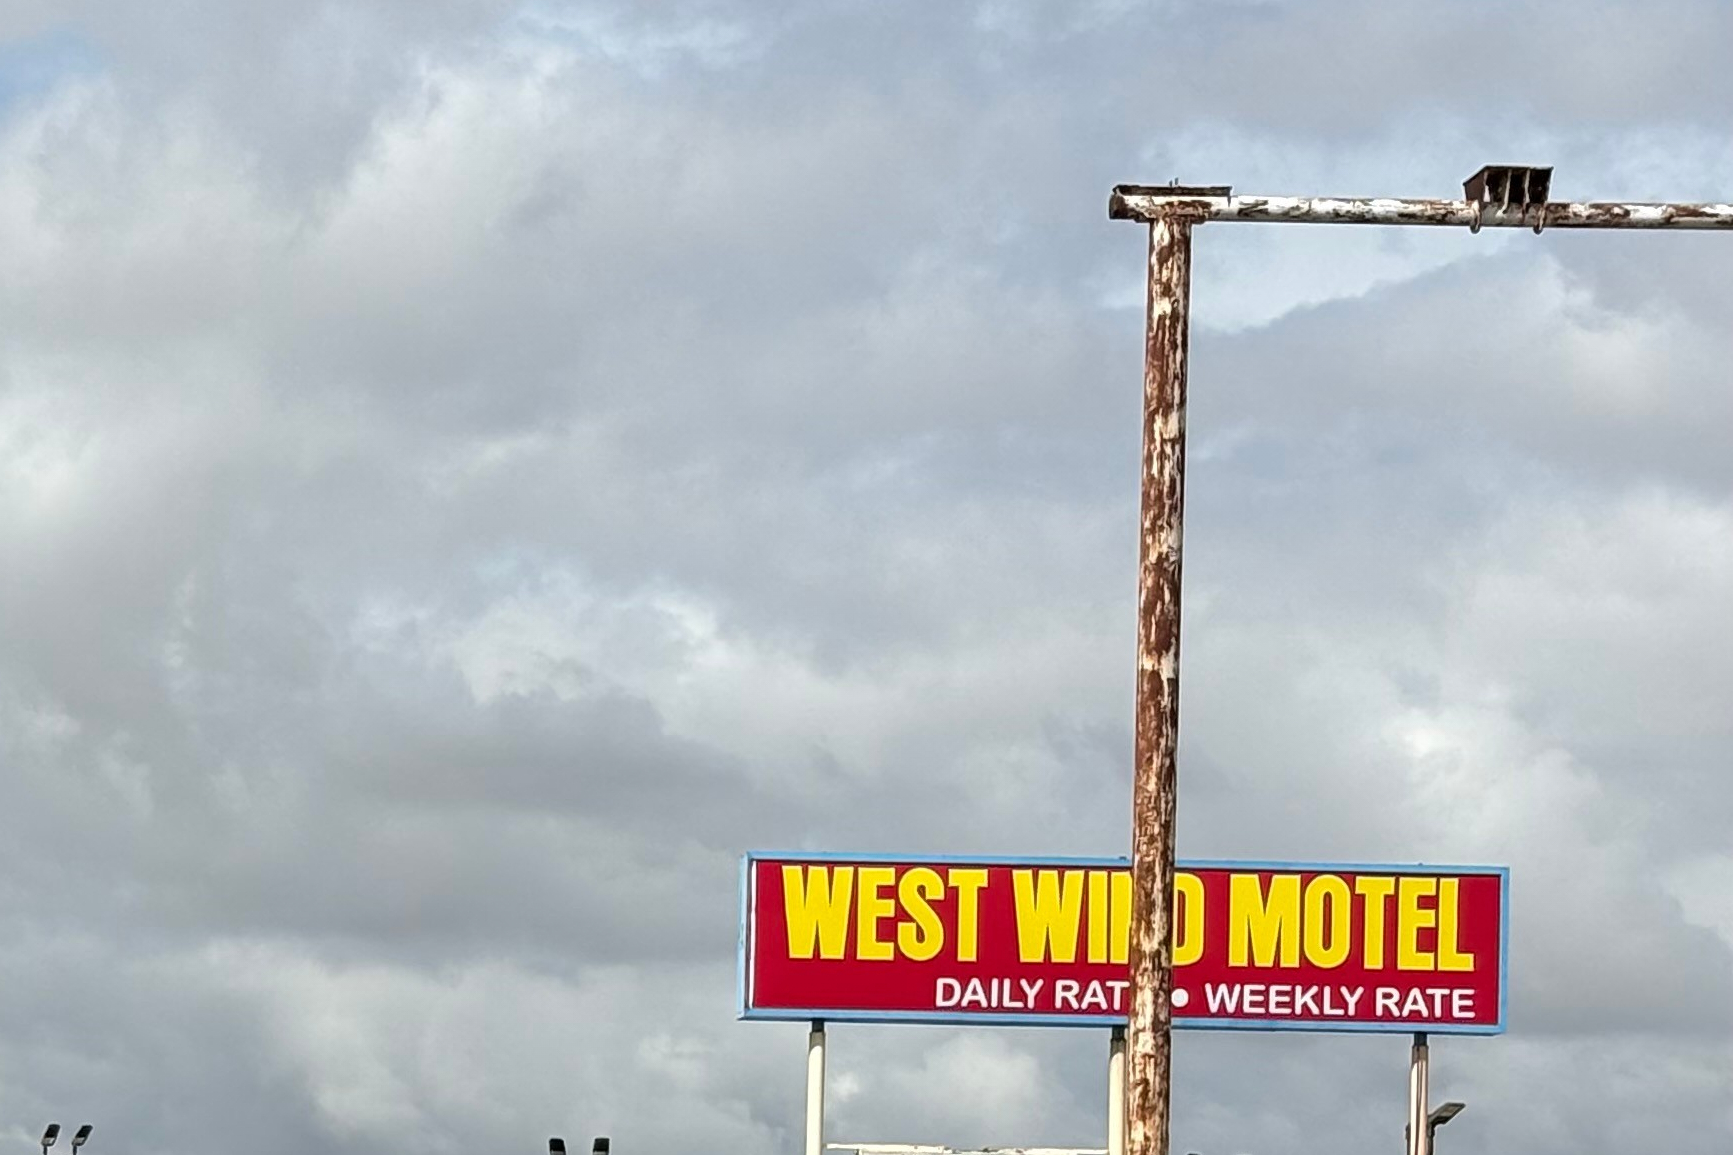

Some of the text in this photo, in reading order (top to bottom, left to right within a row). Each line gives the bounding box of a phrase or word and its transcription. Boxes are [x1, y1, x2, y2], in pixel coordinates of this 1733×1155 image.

[781, 865, 989, 963] WEST
[1228, 873, 1475, 972] MOTEL
[935, 977, 1476, 1019] DAILY RAT WEEKLY RATE
